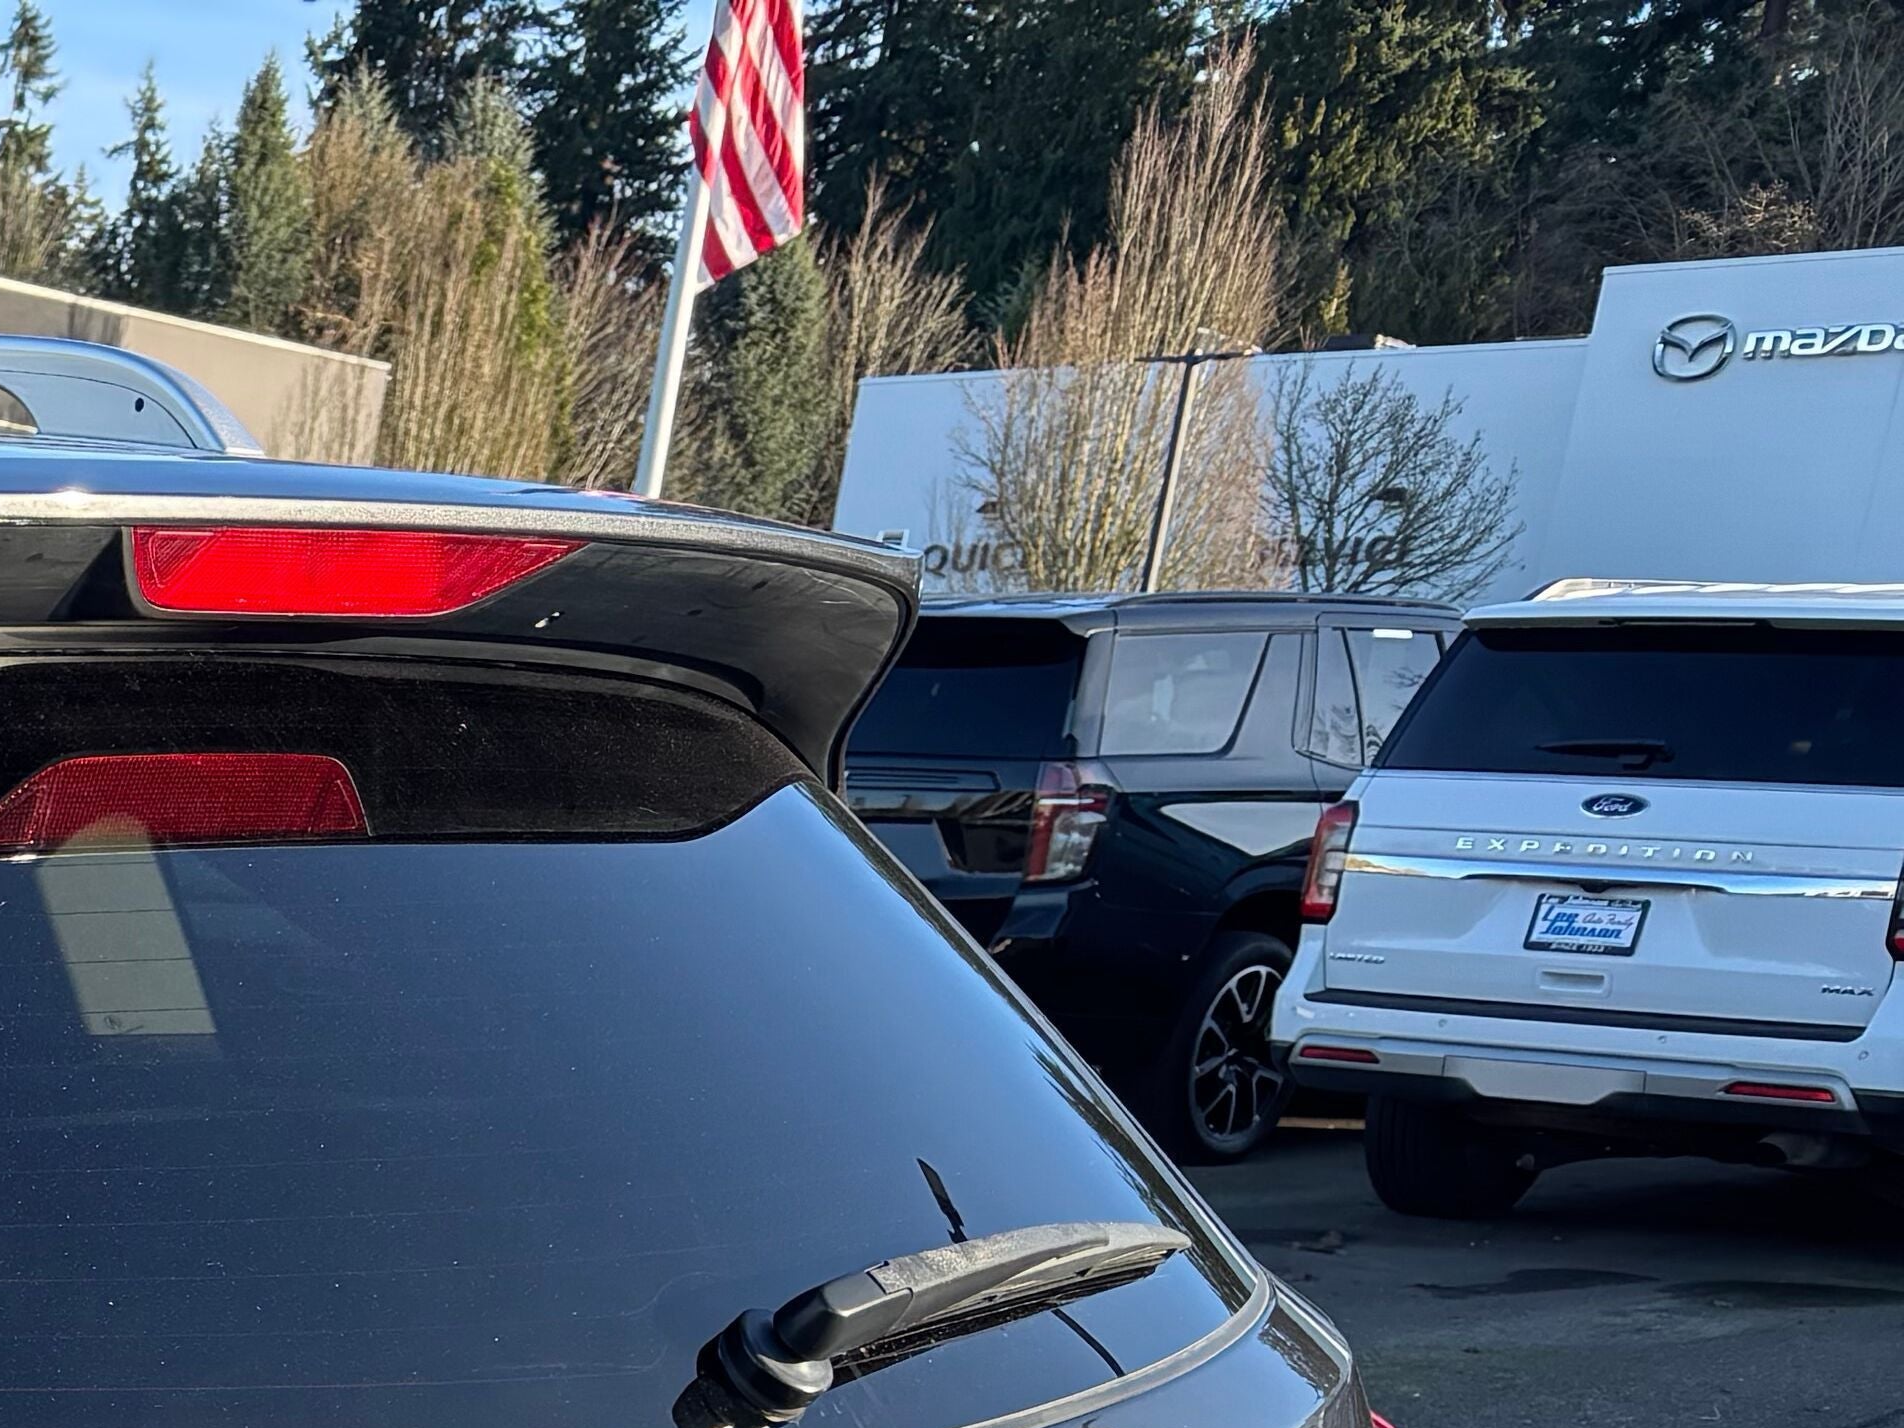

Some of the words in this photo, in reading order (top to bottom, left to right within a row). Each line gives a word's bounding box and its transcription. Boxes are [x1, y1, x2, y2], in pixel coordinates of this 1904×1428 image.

[924, 543, 1050, 577] QUIC
[1592, 796, 1632, 812] Ford
[1455, 836, 1753, 863] EXPEDITION
[1821, 984, 1874, 997] MAX
